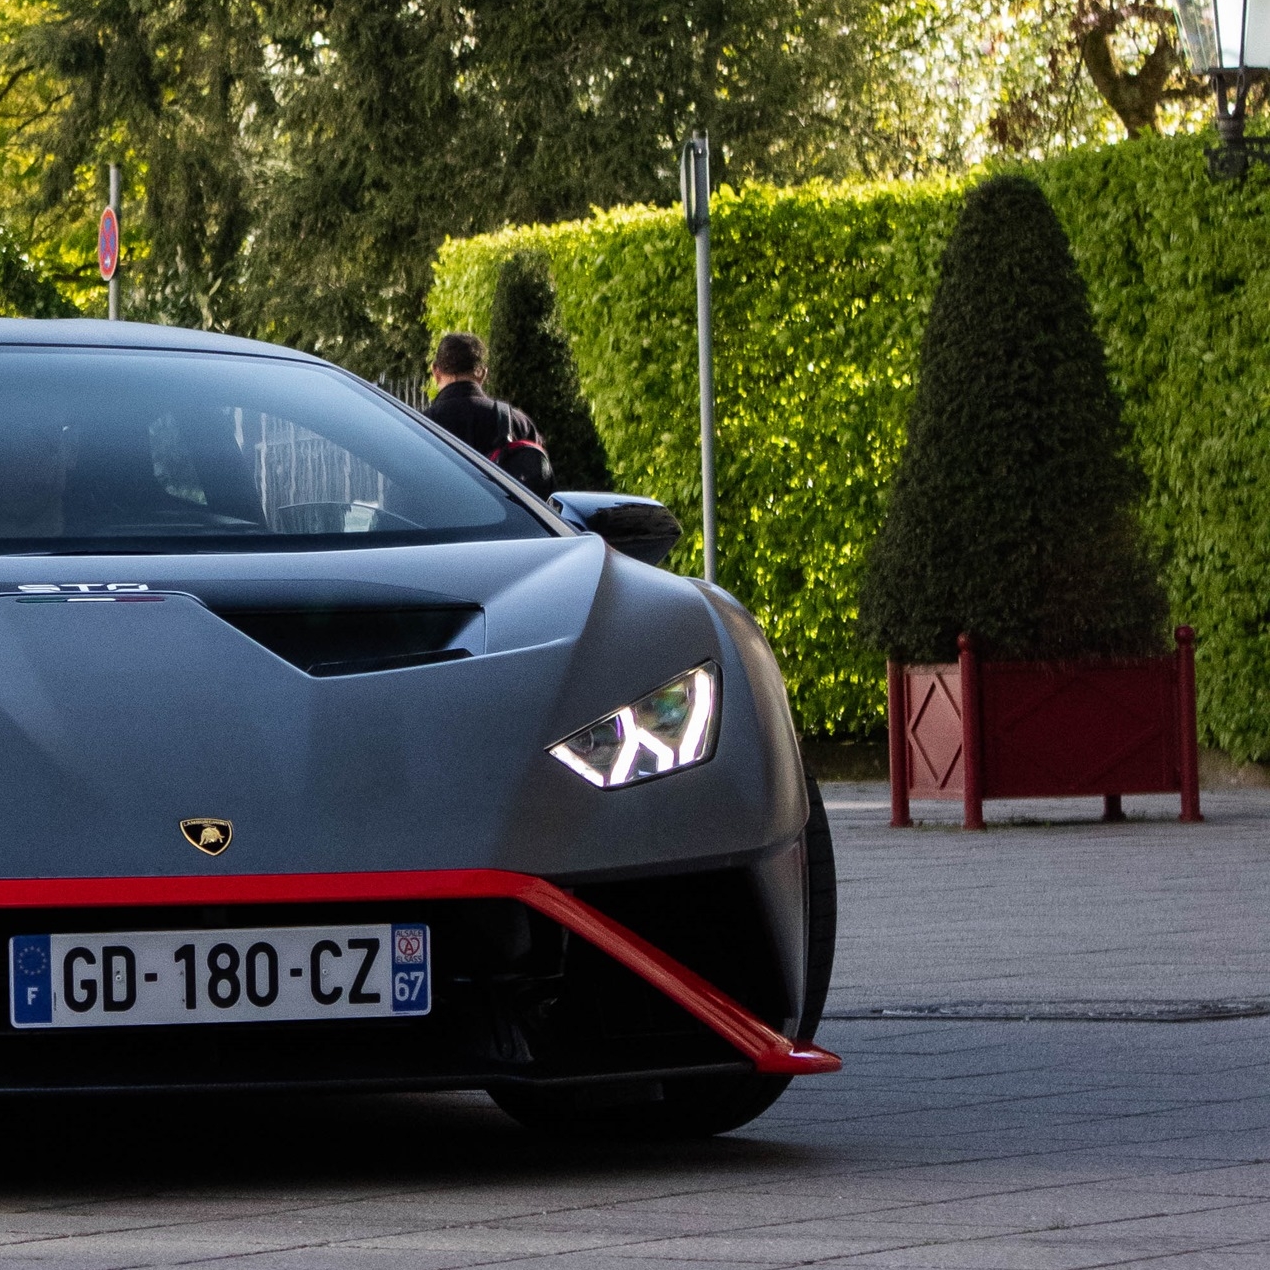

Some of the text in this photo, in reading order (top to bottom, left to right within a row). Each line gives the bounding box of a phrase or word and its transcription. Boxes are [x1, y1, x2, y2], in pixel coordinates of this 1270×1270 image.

[395, 929, 423, 938] ALSACE
[396, 955, 423, 963] ELSASS
[63, 938, 381, 1013] GD-180-CZ
[27, 986, 38, 1006] F
[394, 971, 425, 1001] 67
